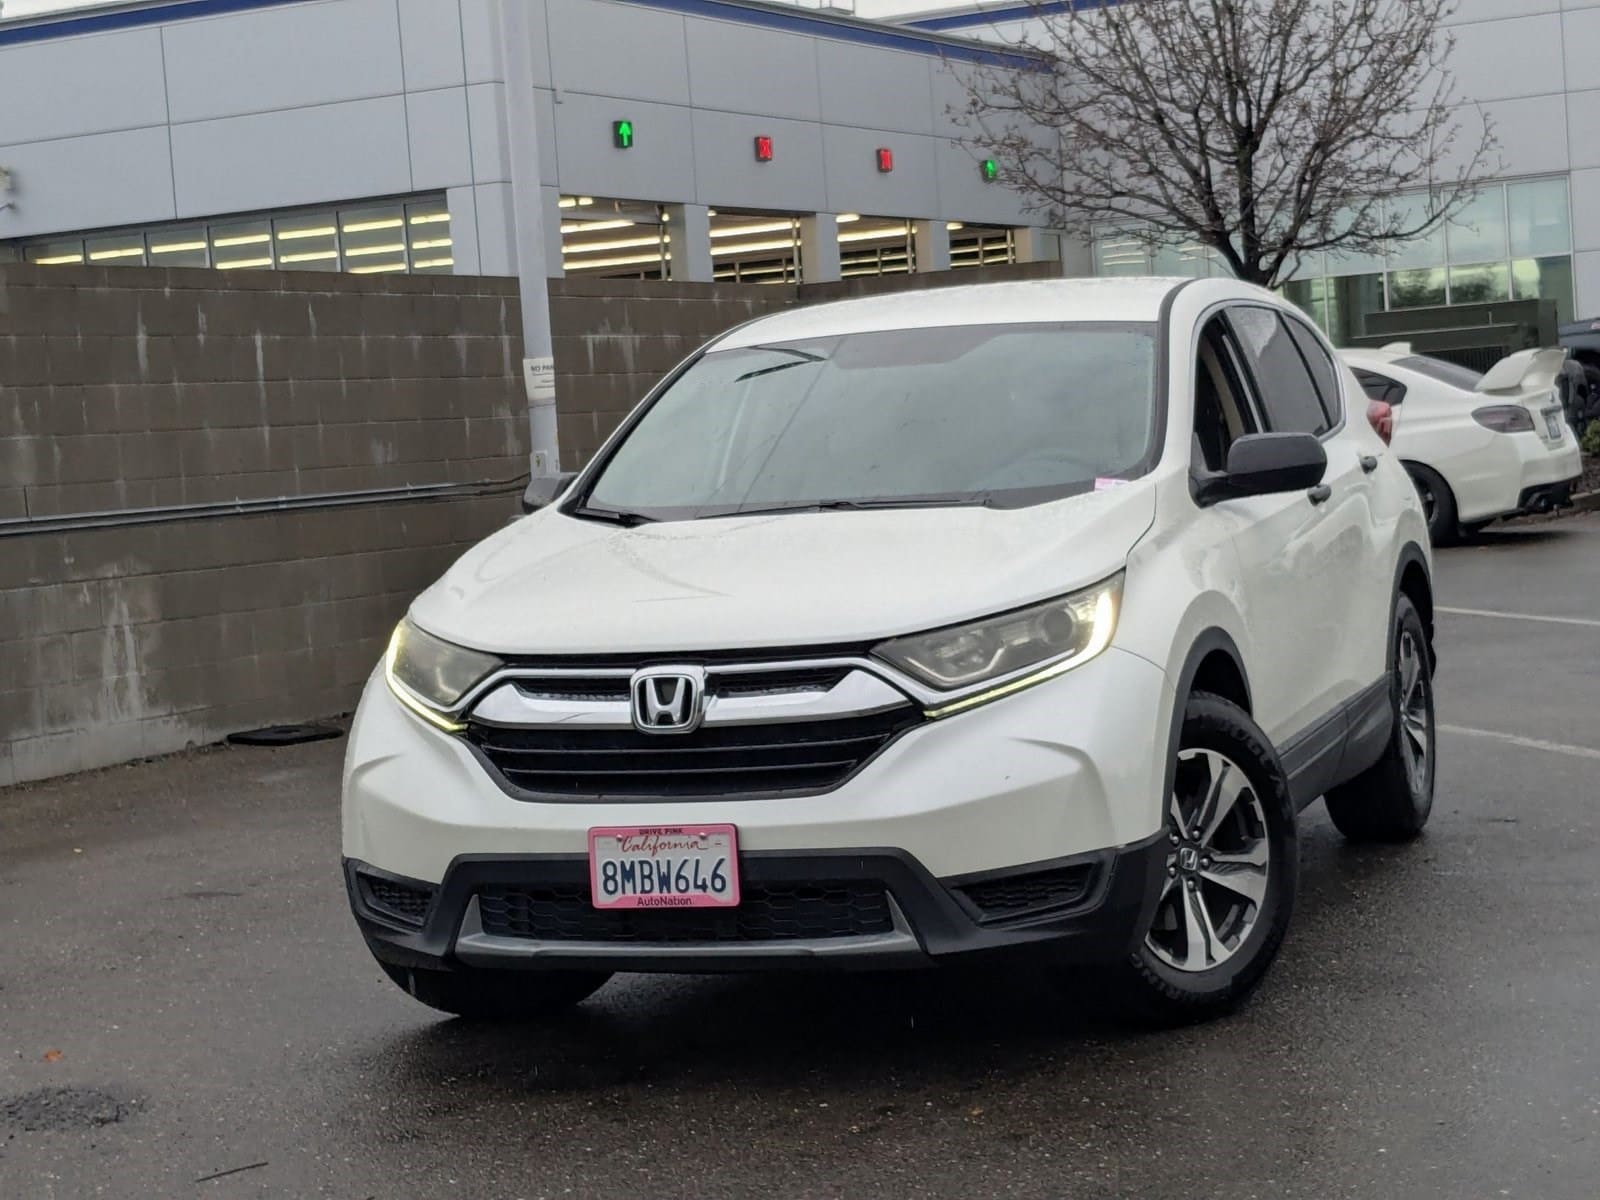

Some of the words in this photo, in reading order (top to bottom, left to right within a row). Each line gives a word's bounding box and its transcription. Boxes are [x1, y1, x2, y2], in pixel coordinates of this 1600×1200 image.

[621, 835, 708, 857] California
[601, 857, 727, 896] 8MBW646
[636, 895, 693, 907] AutoNation
